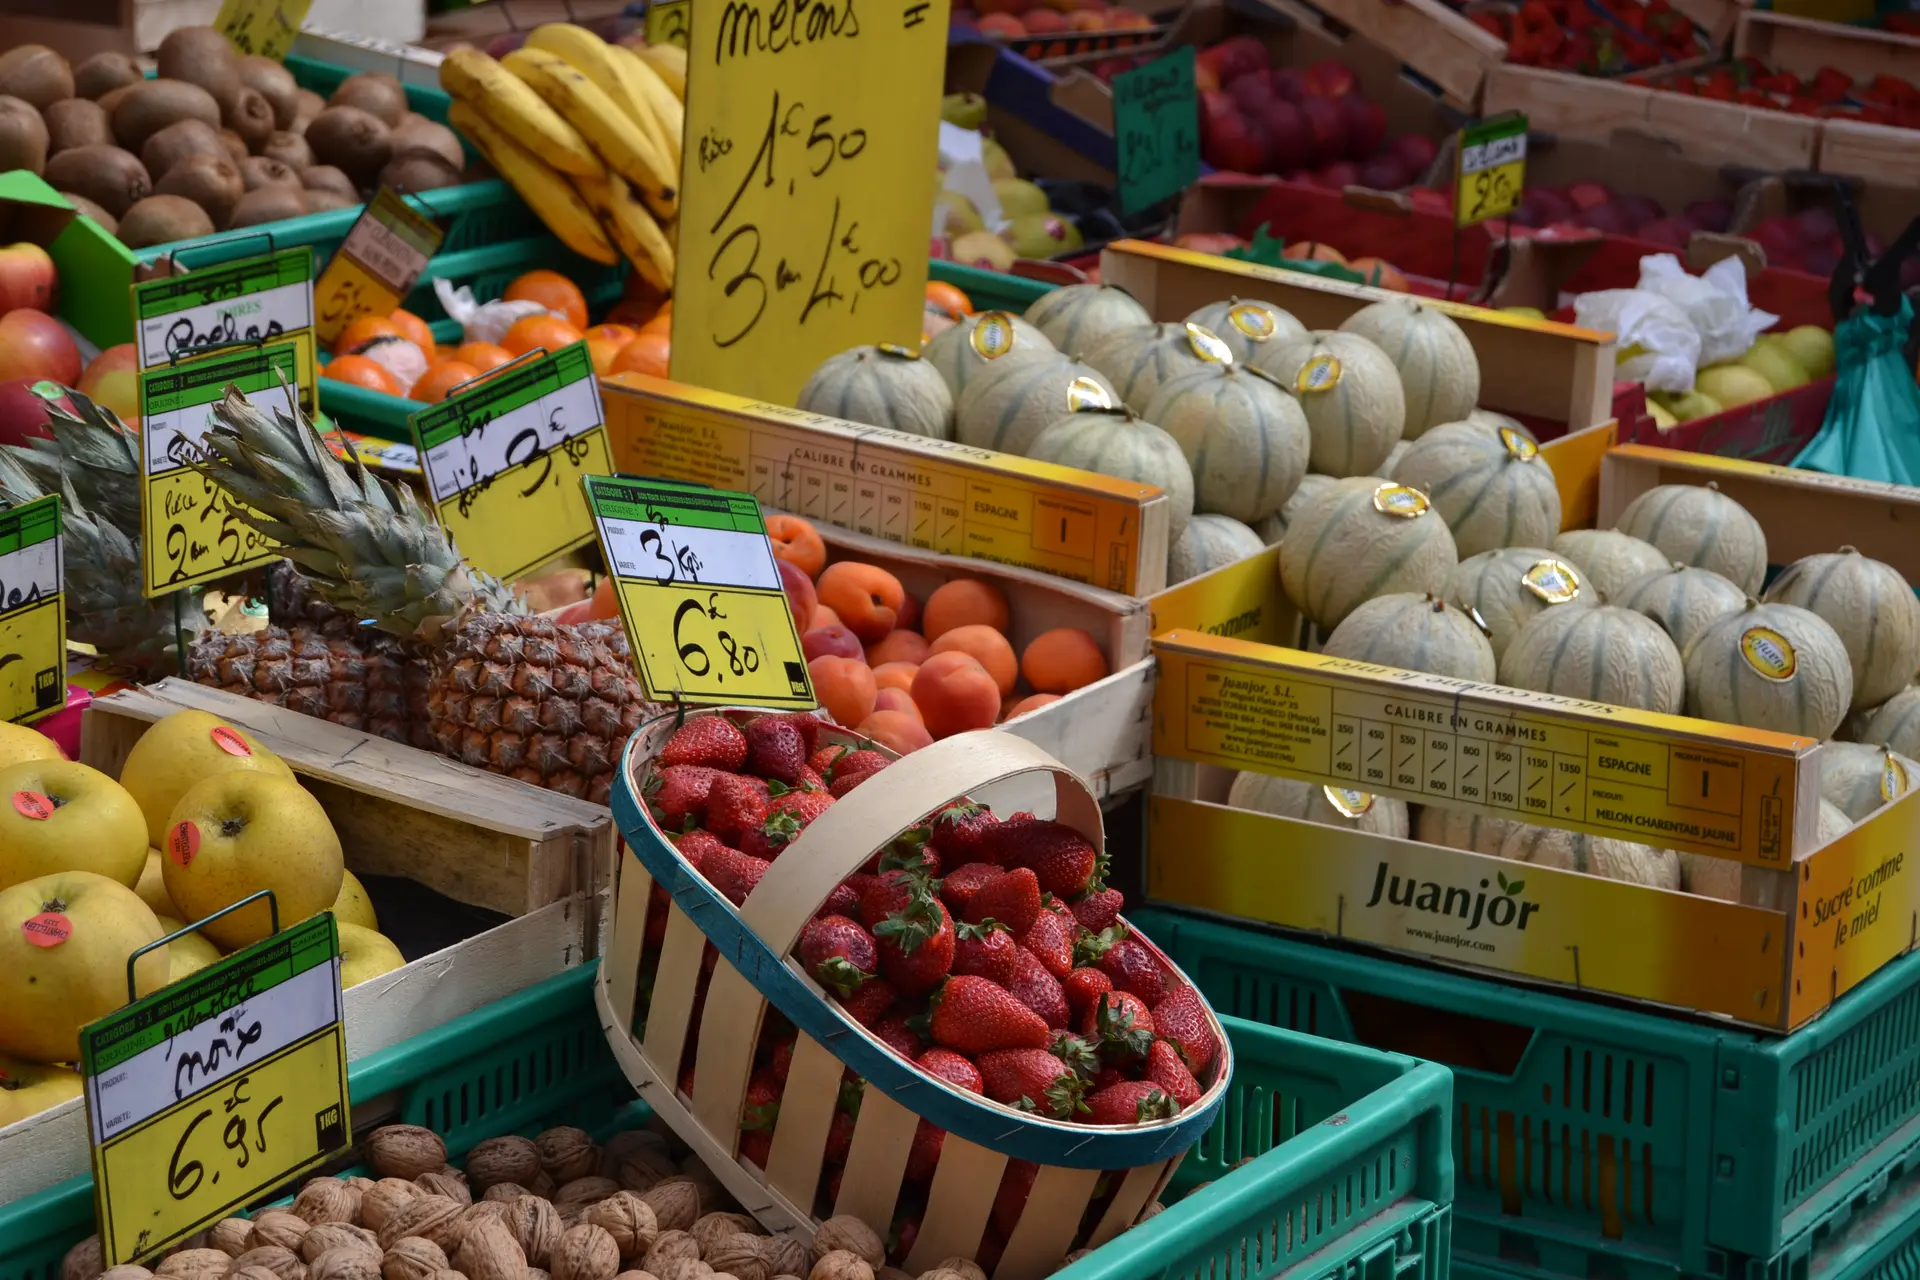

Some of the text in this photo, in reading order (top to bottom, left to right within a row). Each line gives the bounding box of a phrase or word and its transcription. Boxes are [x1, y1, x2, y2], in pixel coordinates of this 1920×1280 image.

[216, 301, 263, 320] POIRES
[793, 446, 845, 468] CALIBRE
[870, 463, 933, 488] GRAMMES
[973, 501, 1019, 521] ESPAGNE
[639, 529, 676, 587] 3
[37, 671, 56, 691] 1KG
[1383, 702, 1444, 725] CALIBRE
[1473, 718, 1548, 743] GRAMMES
[1367, 727, 1386, 741] 450
[1399, 733, 1417, 747] 550
[1430, 738, 1450, 753] 650
[1494, 750, 1514, 764] 950
[1525, 755, 1550, 770] 1150
[1557, 761, 1582, 776] 1350
[1597, 755, 1653, 776] ESPAGNE
[1366, 767, 1385, 780] 550
[1460, 784, 1480, 798] 950
[1490, 789, 1515, 804] 1150
[1524, 795, 1548, 810] 1350
[1595, 807, 1736, 844] MELON CHARENTAIS JAUNE
[1365, 861, 1541, 932] Juanjor
[1813, 851, 1905, 928] Sucré comme
[28, 922, 69, 939] CHANTECLER
[1833, 891, 1882, 950] le miel
[1405, 926, 1497, 953] www.juanjor.com
[95, 1019, 137, 1047] CATEGORIE
[101, 1071, 128, 1091] PRODUIT:
[105, 1110, 132, 1130] VARIETE:
[319, 1107, 338, 1132] 1KG
